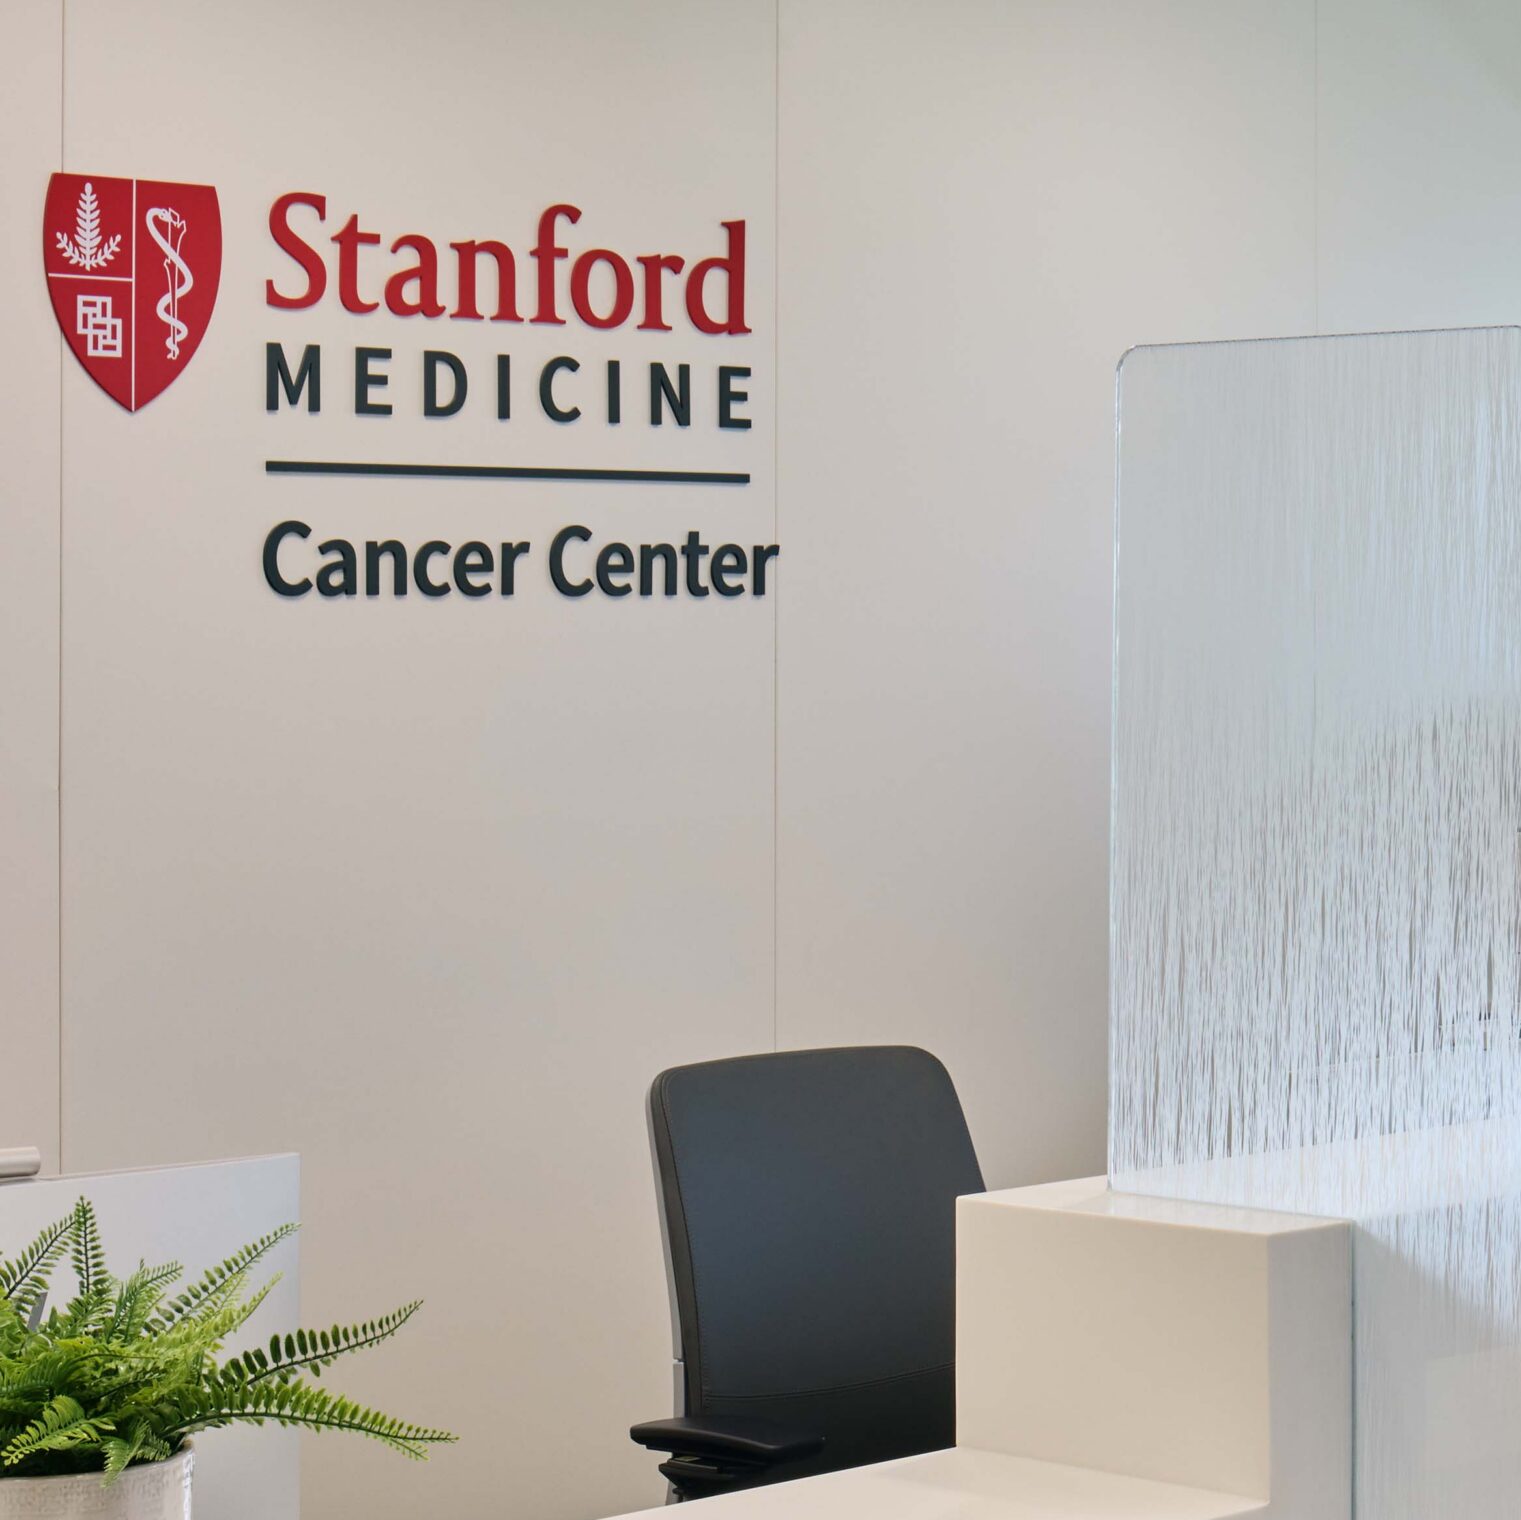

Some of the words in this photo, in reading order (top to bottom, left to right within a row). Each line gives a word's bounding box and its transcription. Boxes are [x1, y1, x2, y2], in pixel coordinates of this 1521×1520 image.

[265, 191, 752, 336] Stanford
[265, 342, 752, 430] MEDICINE
[262, 520, 531, 598] Cancer
[548, 524, 780, 598] Center
